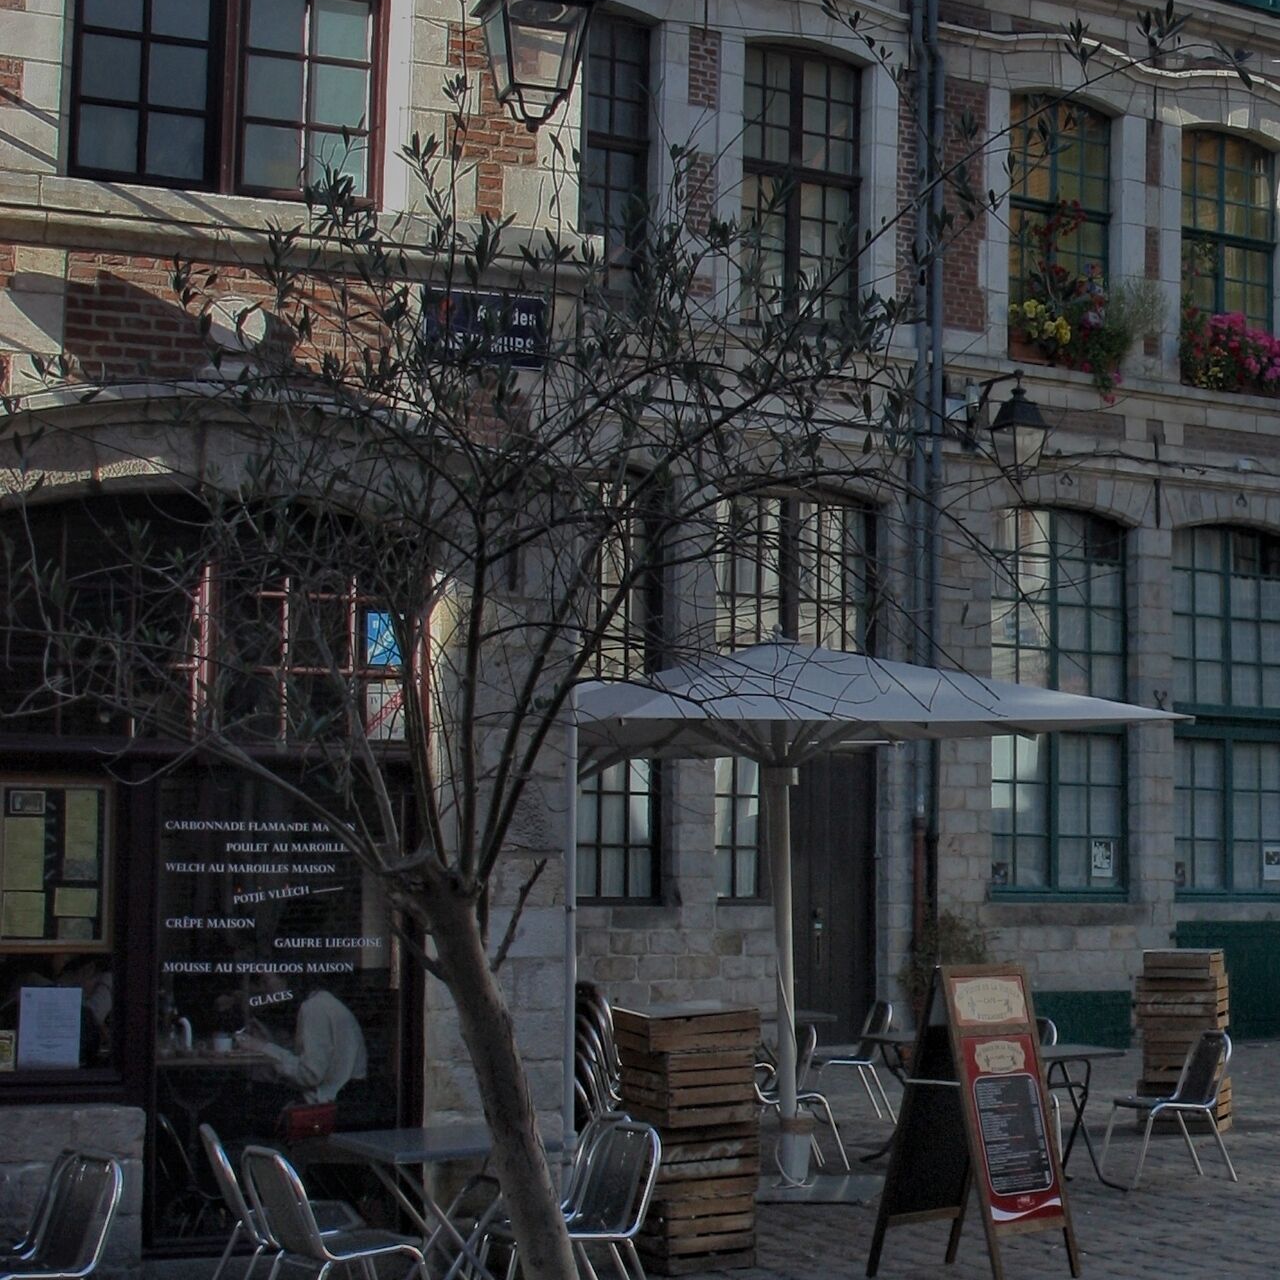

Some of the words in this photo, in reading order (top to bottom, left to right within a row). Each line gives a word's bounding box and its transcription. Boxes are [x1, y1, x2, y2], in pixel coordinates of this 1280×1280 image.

[165, 820, 246, 832] CARBONNADE
[248, 821, 309, 832] FLAMANDE
[226, 842, 270, 853] POULET
[272, 842, 289, 853] AU
[290, 842, 350, 853] MAROILLE
[165, 862, 206, 873] WELCH
[208, 863, 225, 873] AU
[227, 862, 290, 874] MAROILLES
[291, 863, 336, 873] MAISON
[233, 891, 266, 905] POTJE
[165, 916, 204, 929] CRÊPE
[207, 918, 256, 929] MAISON
[273, 937, 323, 948] GAUFRE
[162, 961, 213, 973] MOUSSE
[214, 962, 233, 973] AU
[236, 962, 304, 973] SPECULOOS
[306, 961, 355, 973] MAISON
[249, 989, 294, 1007] GLACES
